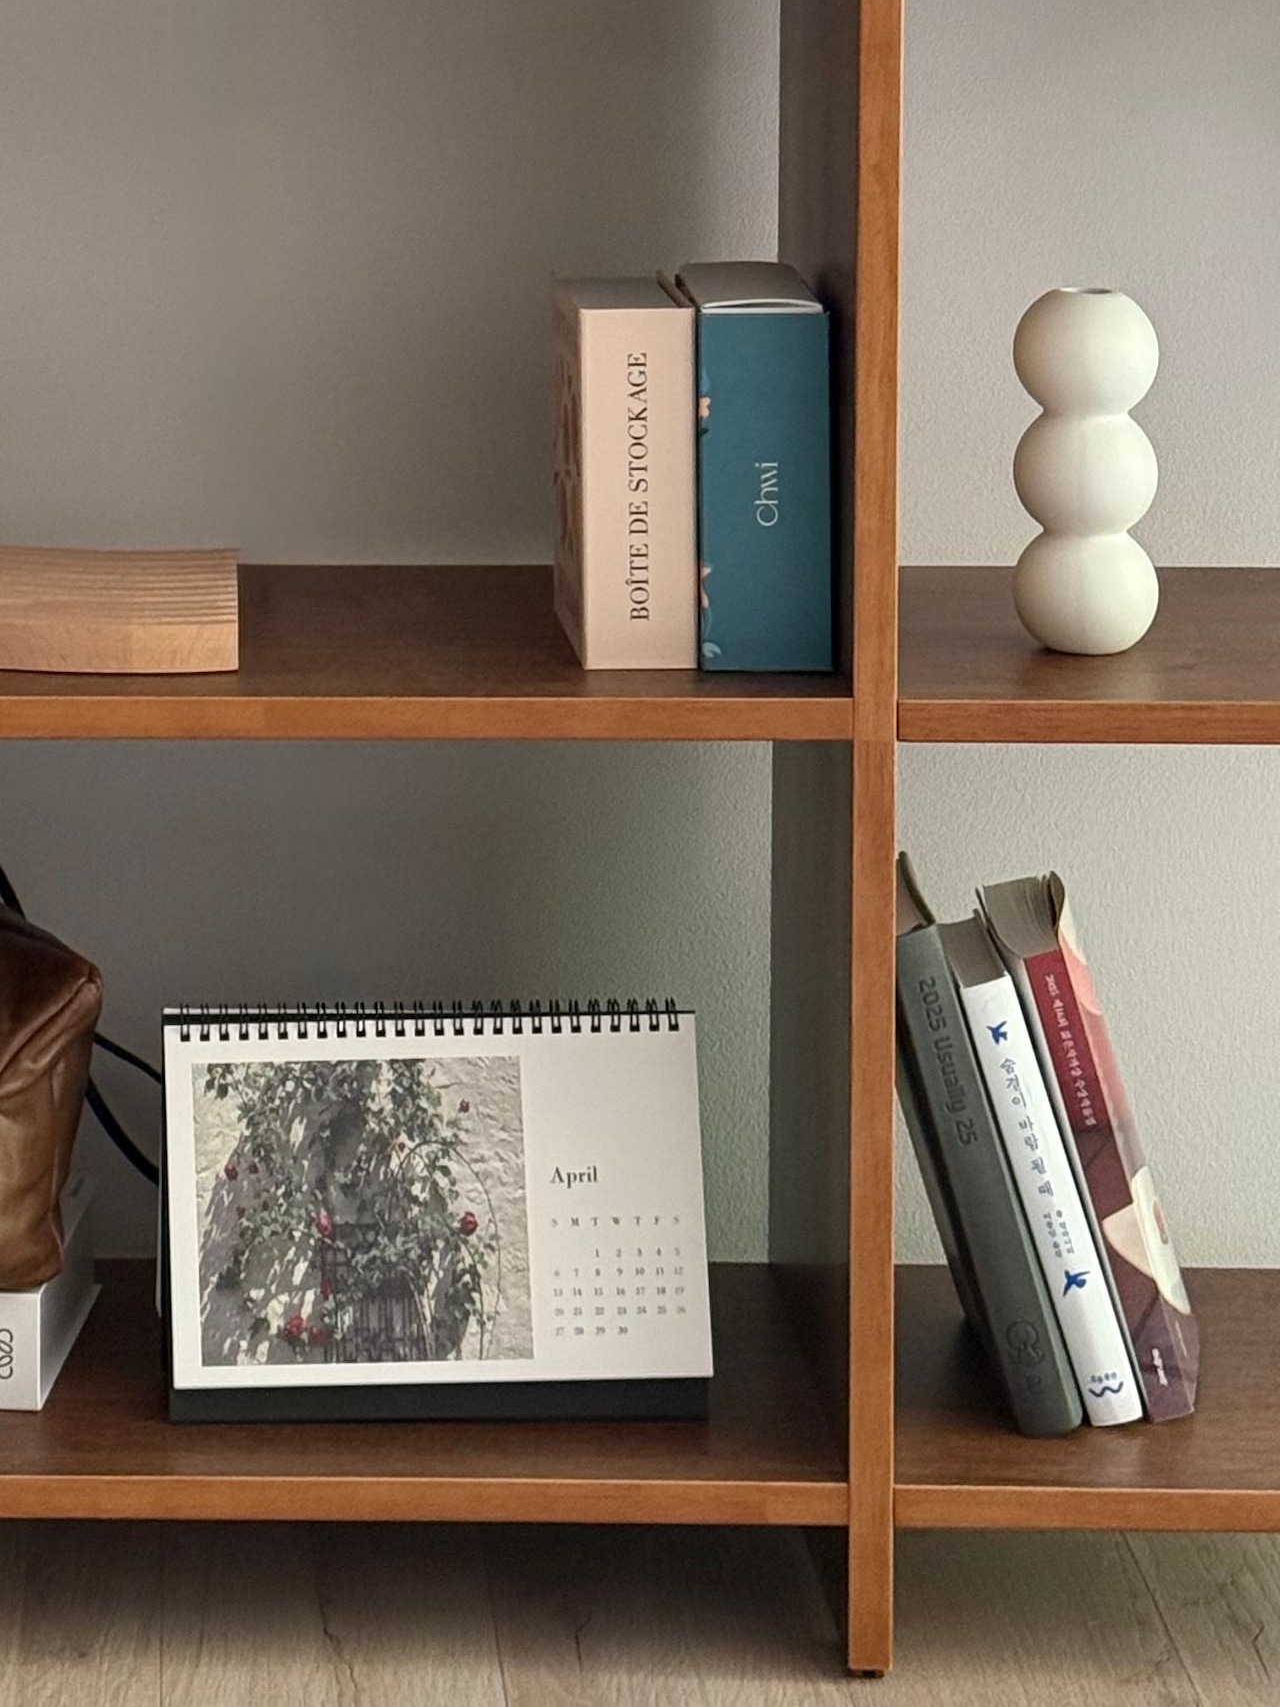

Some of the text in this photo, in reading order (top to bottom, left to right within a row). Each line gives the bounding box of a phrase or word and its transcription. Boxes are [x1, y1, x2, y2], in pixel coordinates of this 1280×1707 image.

[624, 352, 651, 622] BOÎTE DE STOCKAGE
[754, 460, 779, 527] Chwi
[918, 976, 979, 1146] 2025 Usually 25
[999, 1057, 1028, 1110] 숨결이
[1018, 1114, 1039, 1153] 바람
[549, 1165, 599, 1190] April
[1030, 1156, 1048, 1176] 될
[1037, 1179, 1054, 1198] 때
